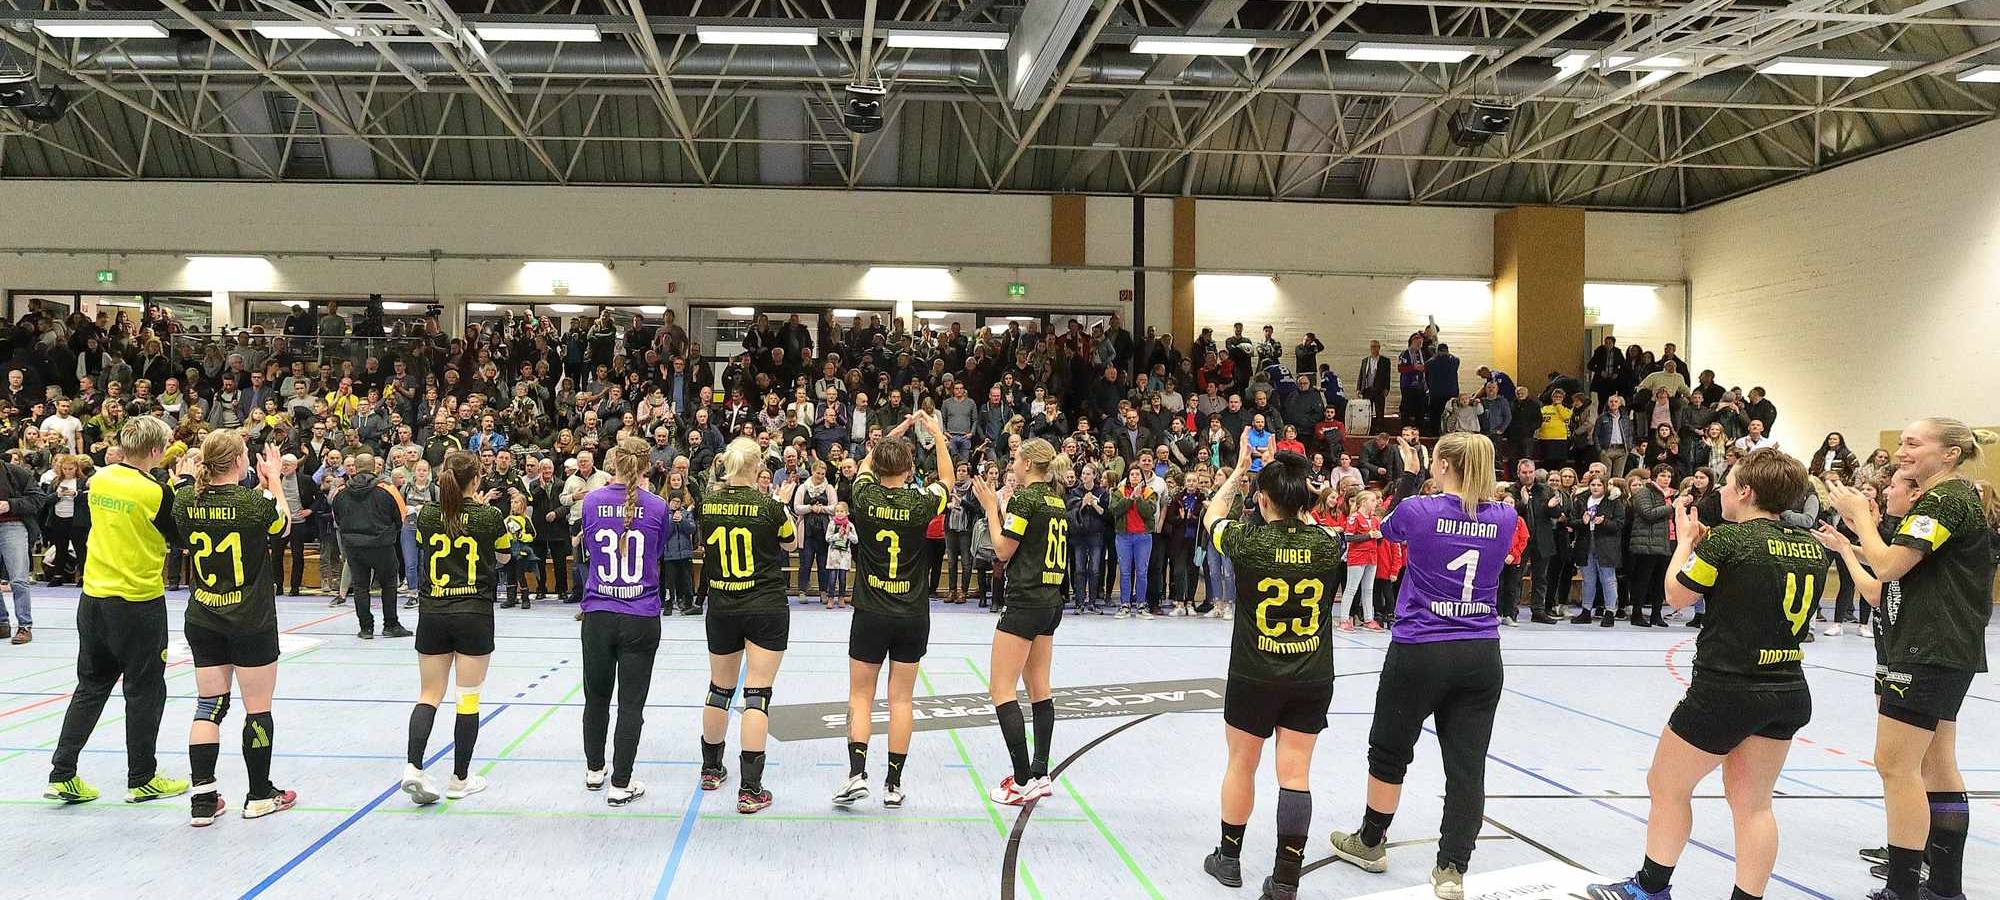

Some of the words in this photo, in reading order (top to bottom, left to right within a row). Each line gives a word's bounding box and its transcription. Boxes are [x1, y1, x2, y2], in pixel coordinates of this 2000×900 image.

[186, 506, 206, 520] VAN
[597, 505, 614, 518] TEN
[1436, 518, 1498, 539] DUIJNDAM
[189, 531, 245, 588] 21
[429, 533, 480, 587] 27
[594, 528, 645, 584] 30
[706, 526, 755, 579] 10
[875, 529, 901, 579] 7
[1044, 516, 1068, 570] 66
[1275, 547, 1312, 564] HUBER
[1767, 539, 1823, 560] GRIJSEELS
[1446, 549, 1480, 602] 1
[1256, 577, 1325, 638] 23
[1783, 572, 1815, 637] 4
[1258, 635, 1320, 655] DORTMUND
